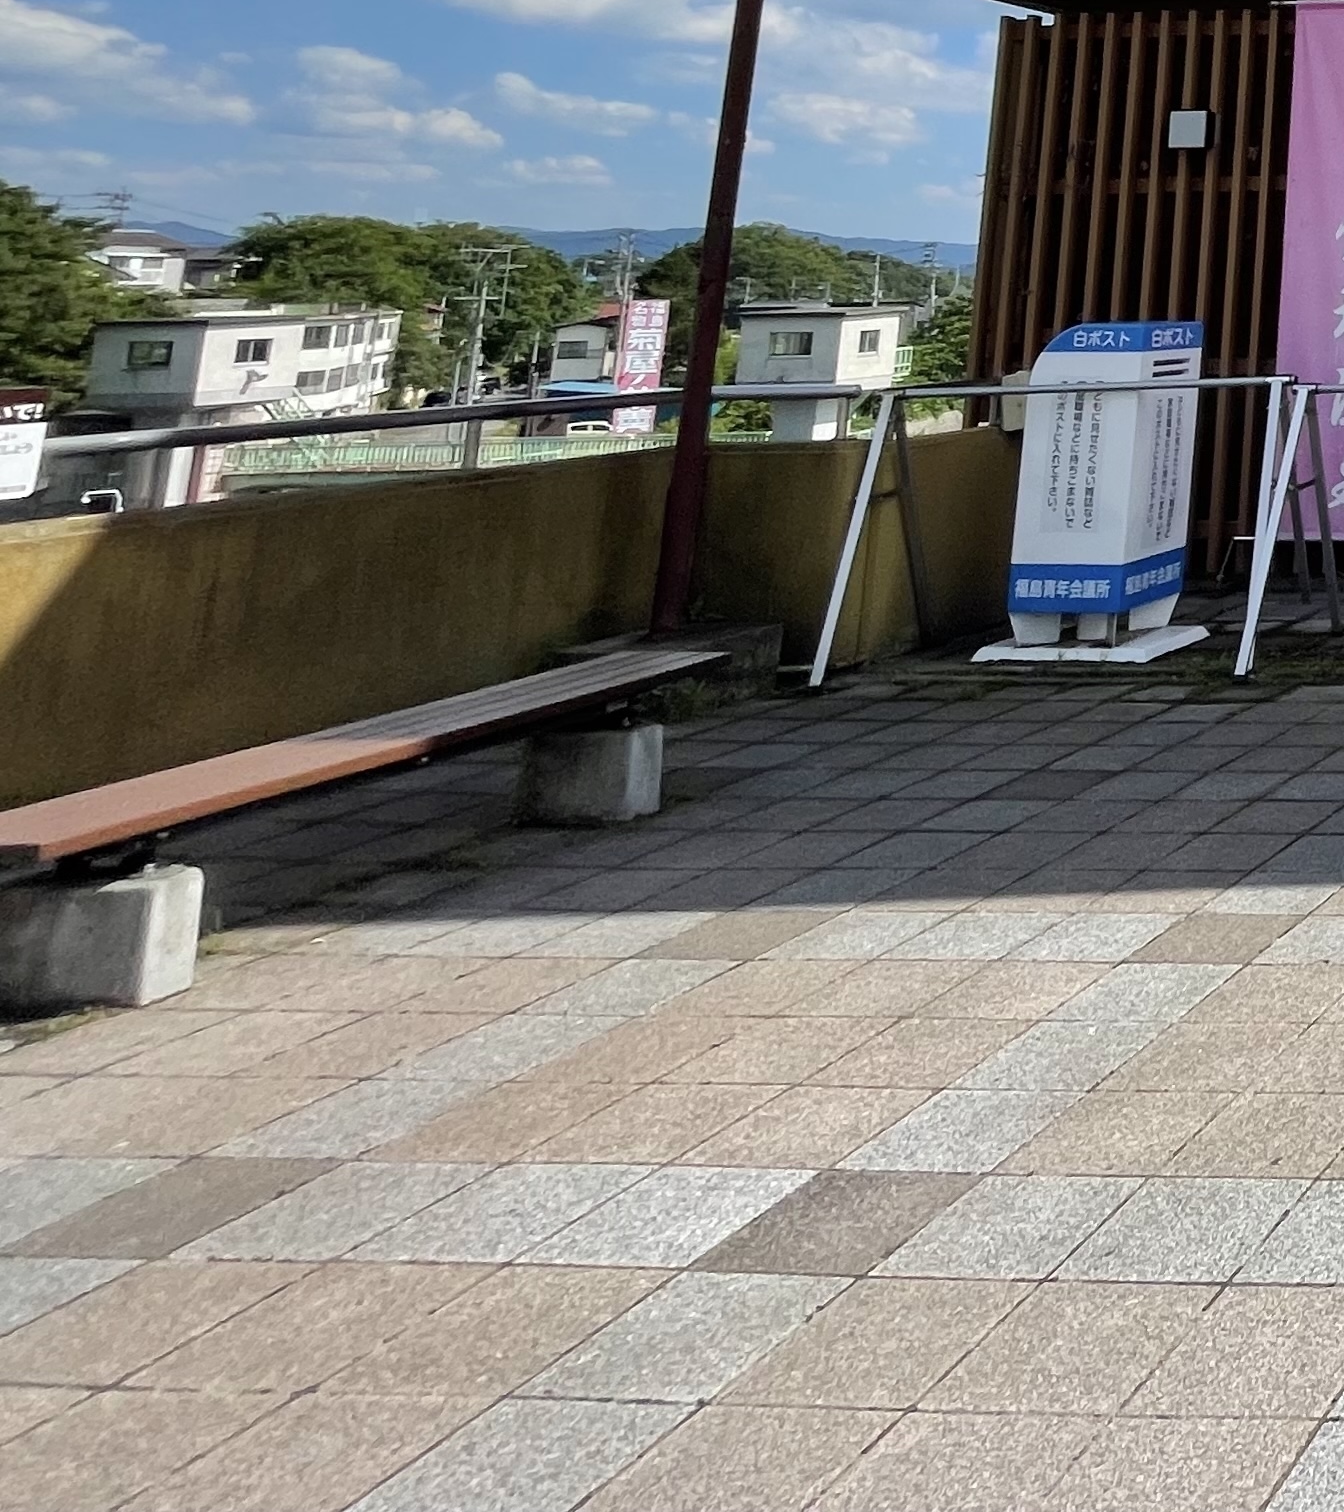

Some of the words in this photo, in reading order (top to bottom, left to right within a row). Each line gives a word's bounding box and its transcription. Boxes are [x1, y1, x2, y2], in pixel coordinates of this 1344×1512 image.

[1072, 329, 1131, 349] 白ポスト
[1150, 327, 1195, 349] 白ポスト
[1047, 380, 1069, 514] のポストに入れて下さい。
[1083, 380, 1105, 529] どもに見せたくない雑誌など
[1014, 578, 1112, 600] 福島青年会議所
